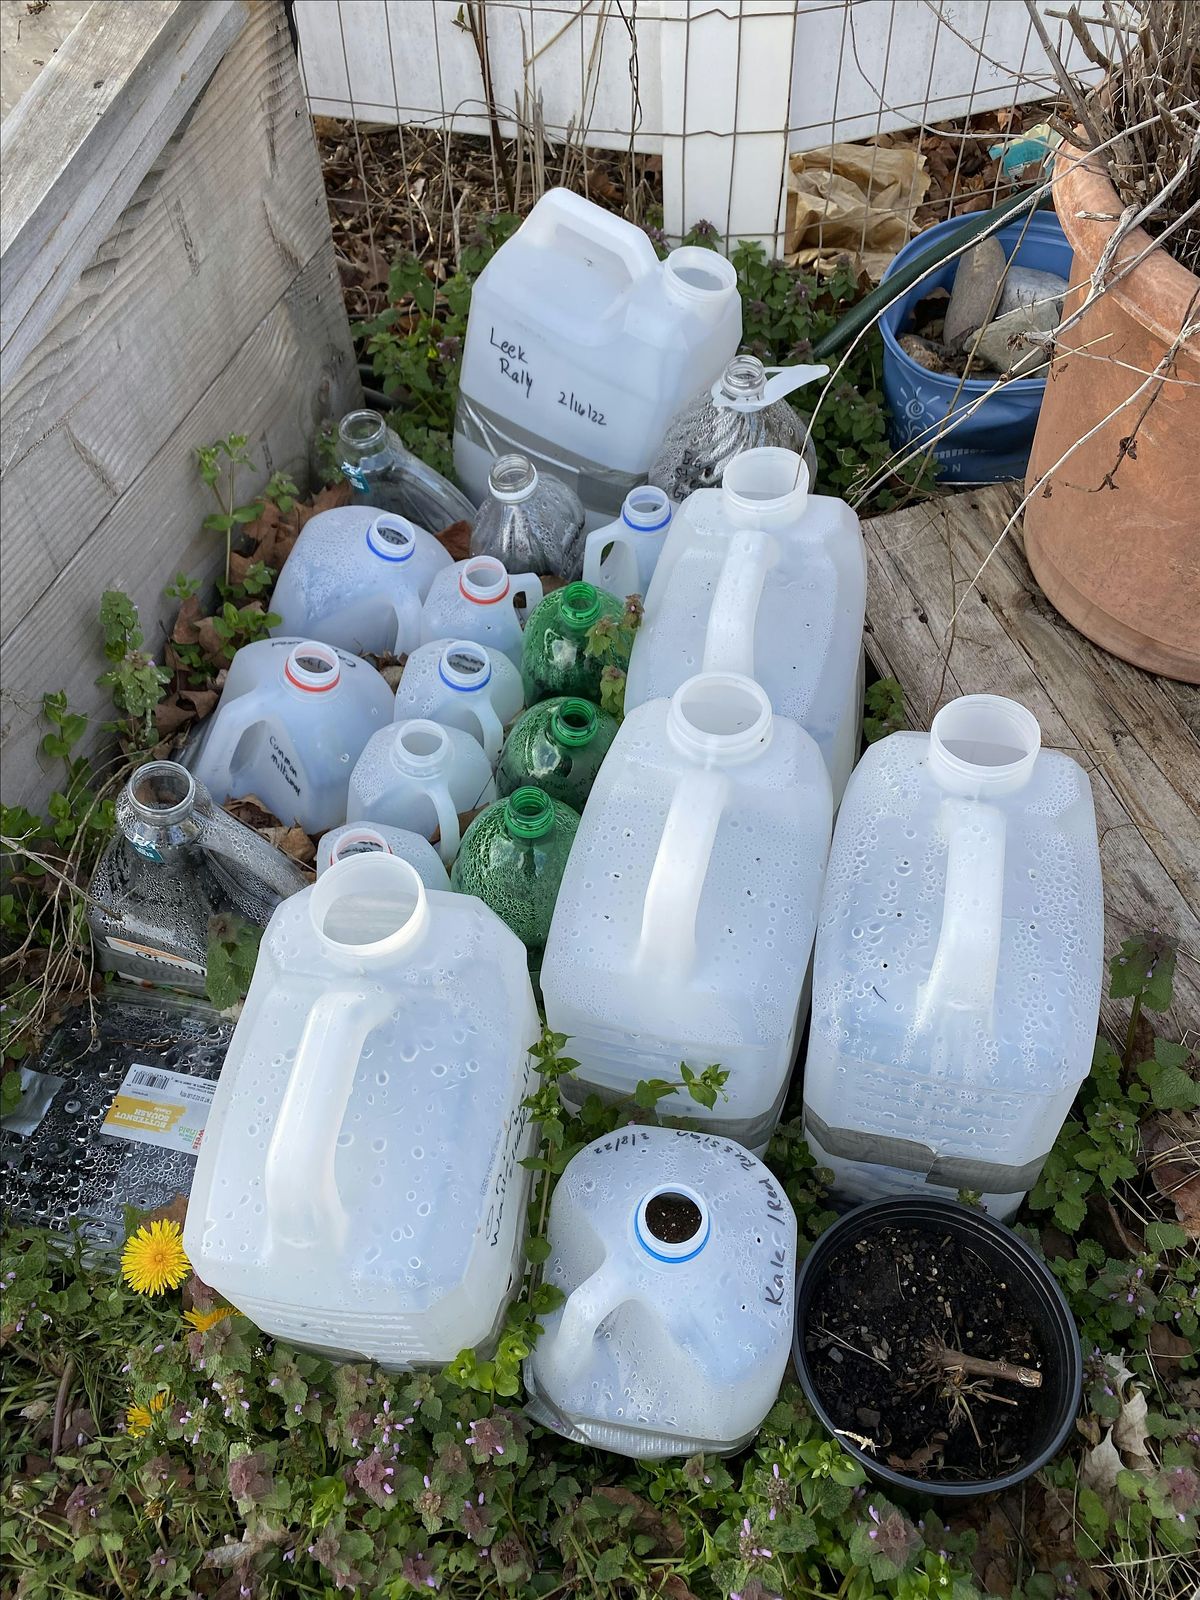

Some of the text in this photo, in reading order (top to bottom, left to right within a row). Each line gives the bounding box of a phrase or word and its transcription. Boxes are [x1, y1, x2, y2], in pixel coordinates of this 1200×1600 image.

[489, 327, 528, 364] Leek
[557, 391, 607, 426] 2/16/22
[114, 1112, 168, 1128] BUTTERNUT
[676, 1131, 757, 1172] Russian
[765, 1249, 787, 1306] Kale
